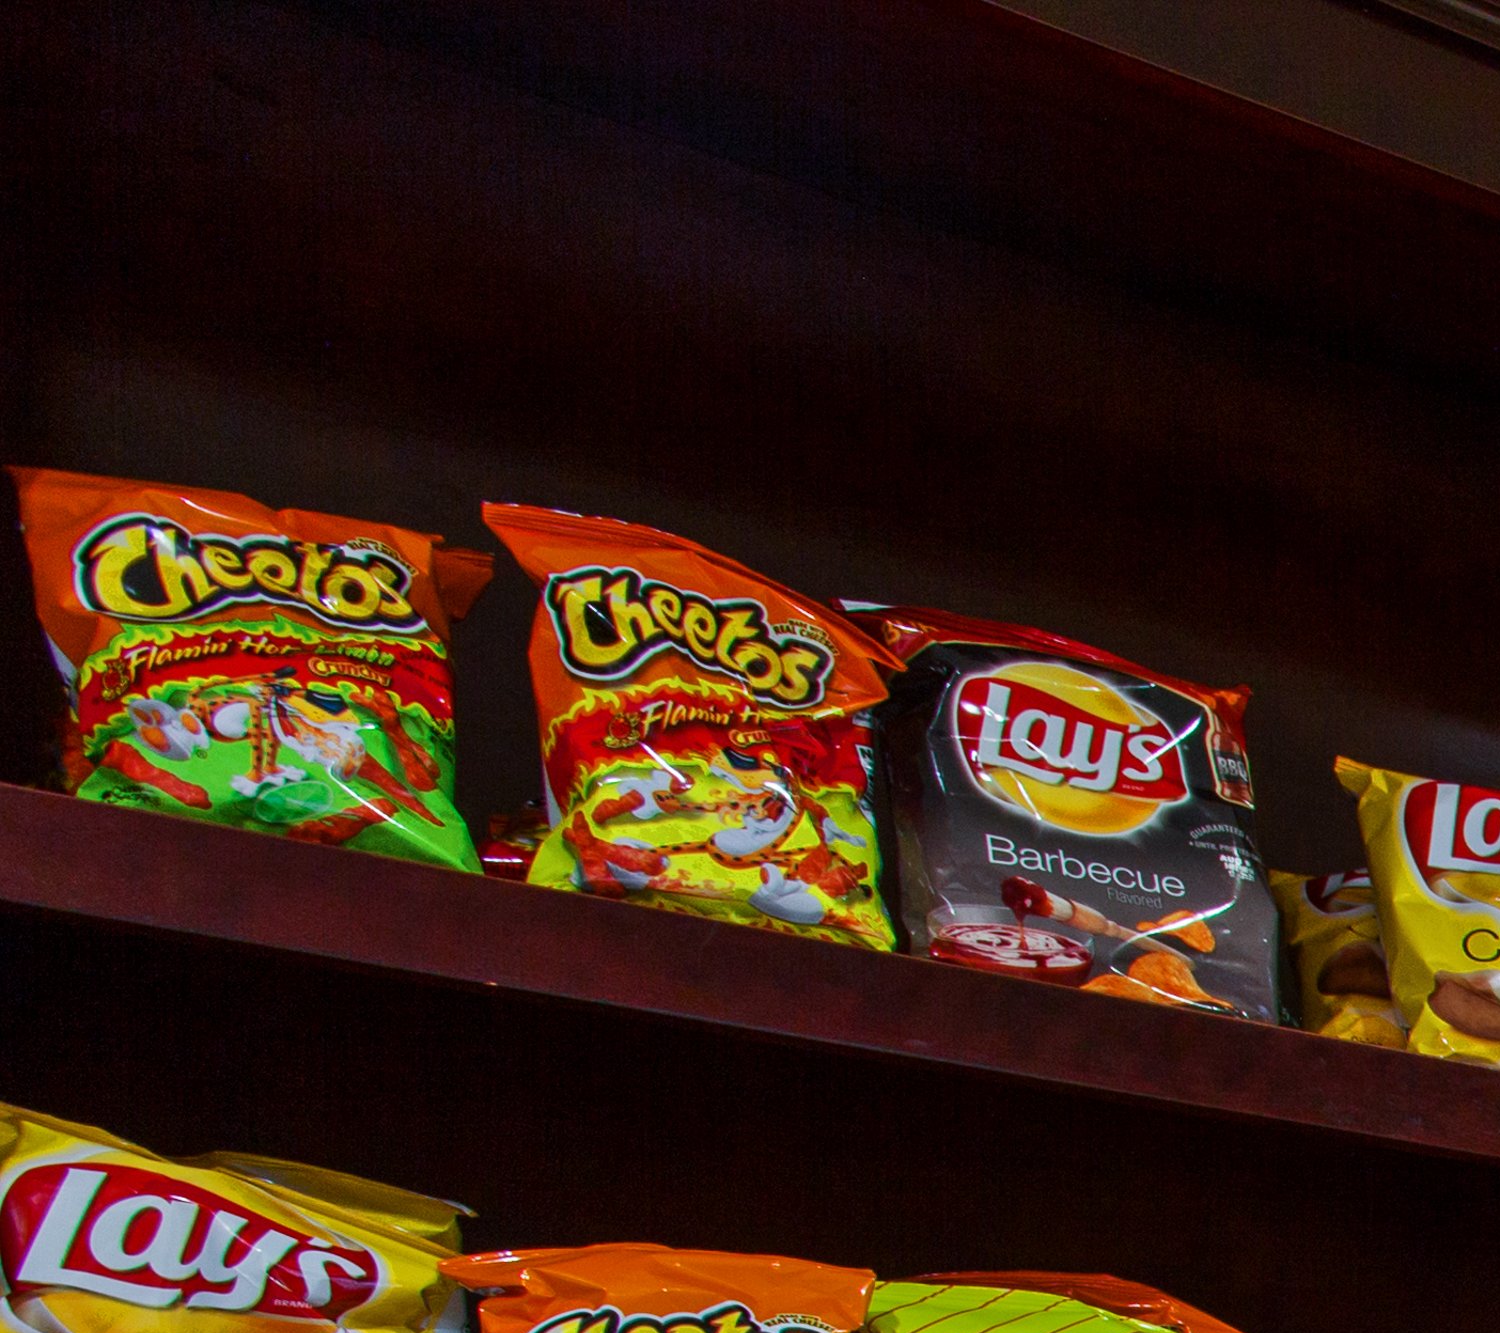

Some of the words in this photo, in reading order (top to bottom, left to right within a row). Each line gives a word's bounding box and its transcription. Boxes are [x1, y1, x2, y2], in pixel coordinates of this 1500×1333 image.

[92, 523, 413, 619] Cheetos
[557, 574, 820, 701] Cheetos
[976, 681, 1169, 792] Lay's
[984, 833, 1186, 898] Barbecue
[1106, 887, 1163, 911] Flavored
[16, 1166, 367, 1312] Lay's
